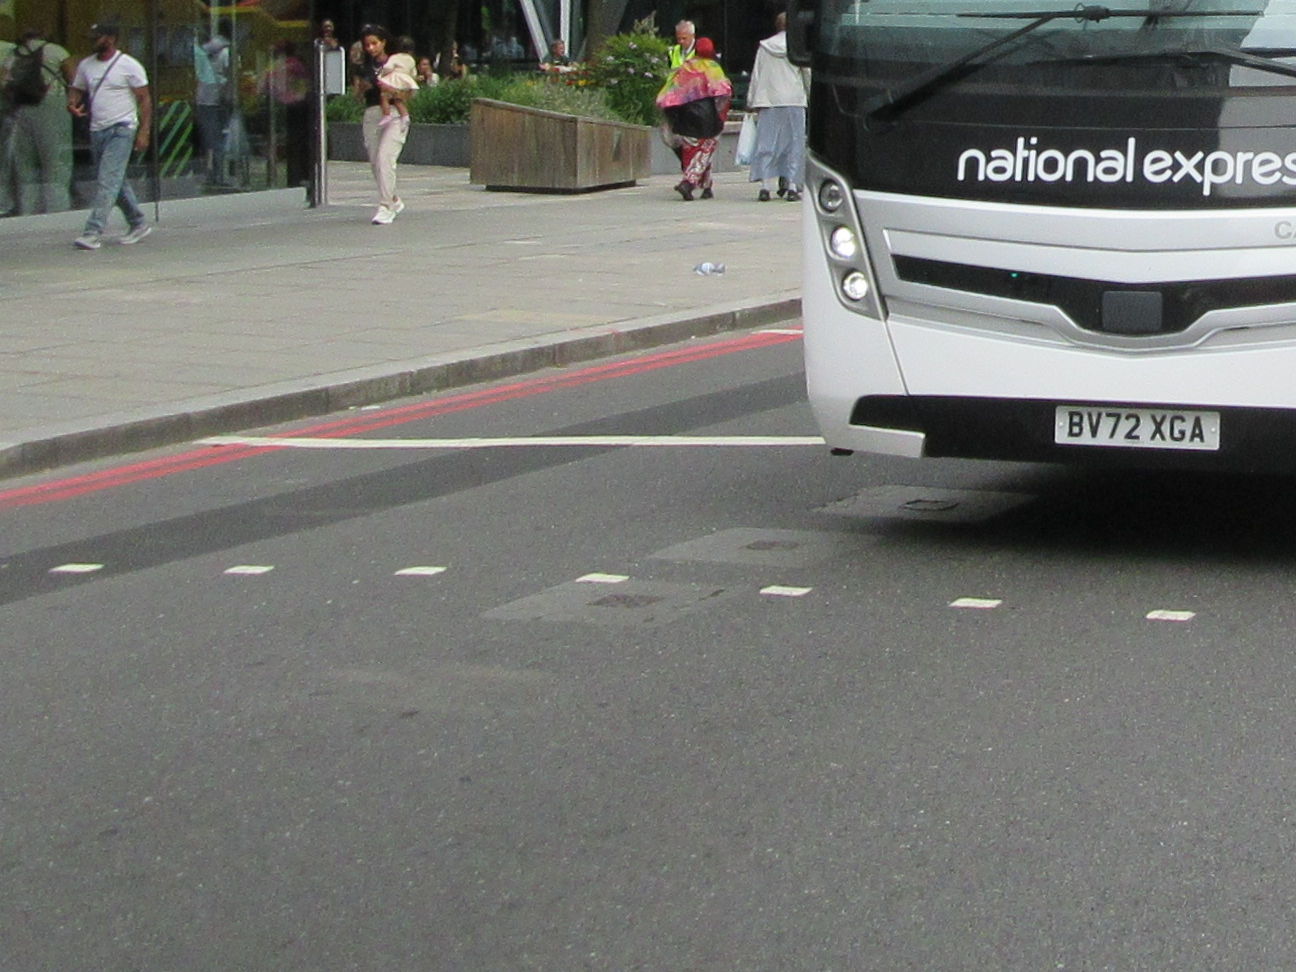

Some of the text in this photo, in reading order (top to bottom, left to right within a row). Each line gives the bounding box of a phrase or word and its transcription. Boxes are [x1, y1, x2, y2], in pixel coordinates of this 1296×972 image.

[957, 136, 1135, 183] national
[1066, 410, 1206, 444] BV72 XGA
